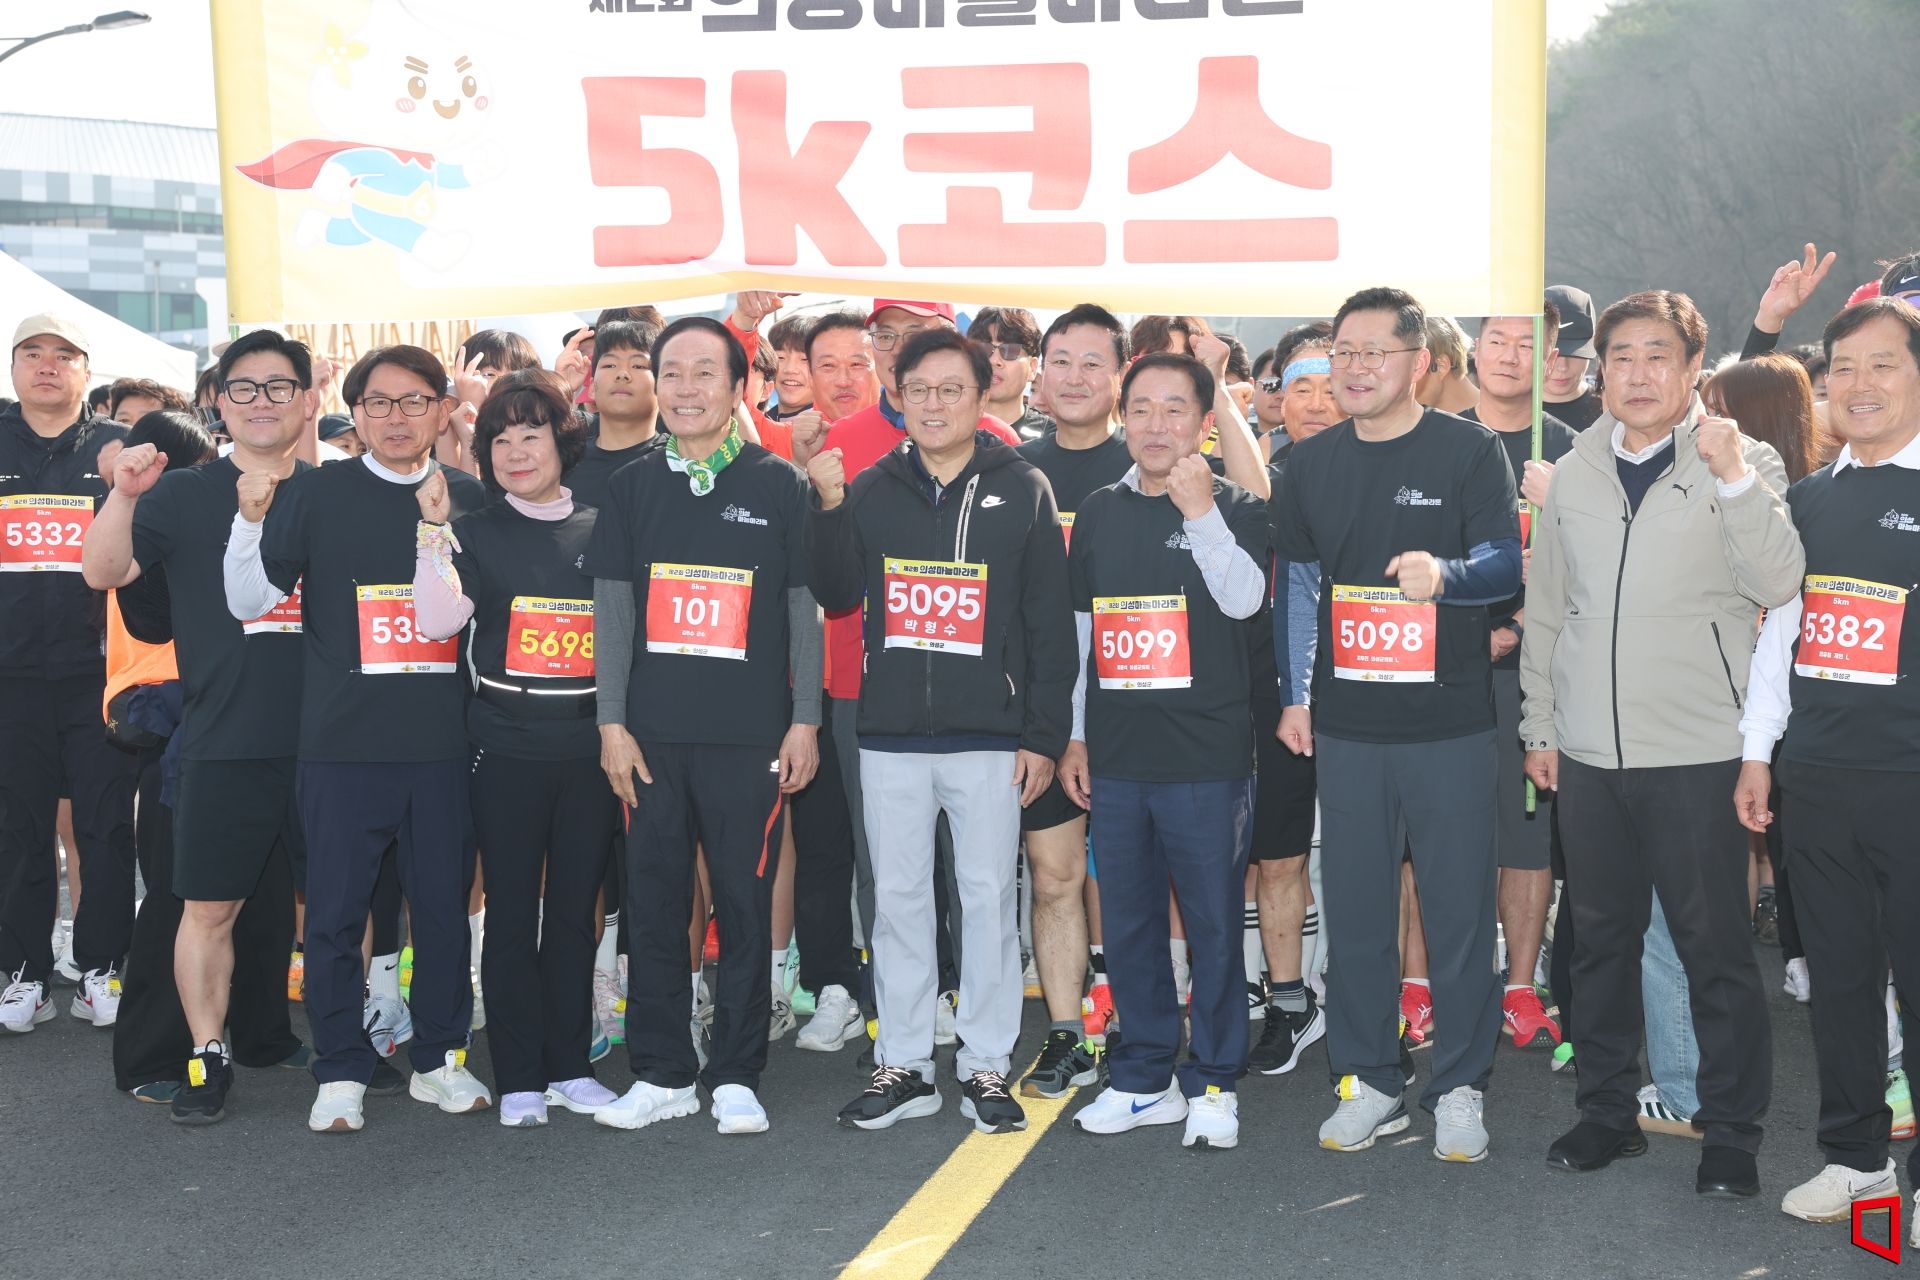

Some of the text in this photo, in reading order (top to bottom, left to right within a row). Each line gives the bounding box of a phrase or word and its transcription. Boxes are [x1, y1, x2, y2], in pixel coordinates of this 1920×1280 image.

[29, 497, 85, 507] 의성마늘마라톤
[6, 521, 83, 547] 5332
[685, 568, 745, 582] 의성마늘마라톤
[919, 565, 979, 578] 의성마늘마라톤
[691, 583, 707, 591] 5km
[1828, 580, 1899, 600] 의성마늘마라톤
[888, 581, 981, 621] 5095
[1120, 599, 1179, 610] 의성마늘마라톤
[1833, 597, 1850, 606] 5km
[672, 596, 720, 627] 101
[1370, 606, 1387, 614] 5km
[555, 616, 571, 624] 5km
[1126, 615, 1141, 623] 5km
[1340, 619, 1423, 652] 5098
[1804, 612, 1885, 651] 5382
[519, 627, 594, 659] 5698
[1102, 628, 1177, 659] 5099
